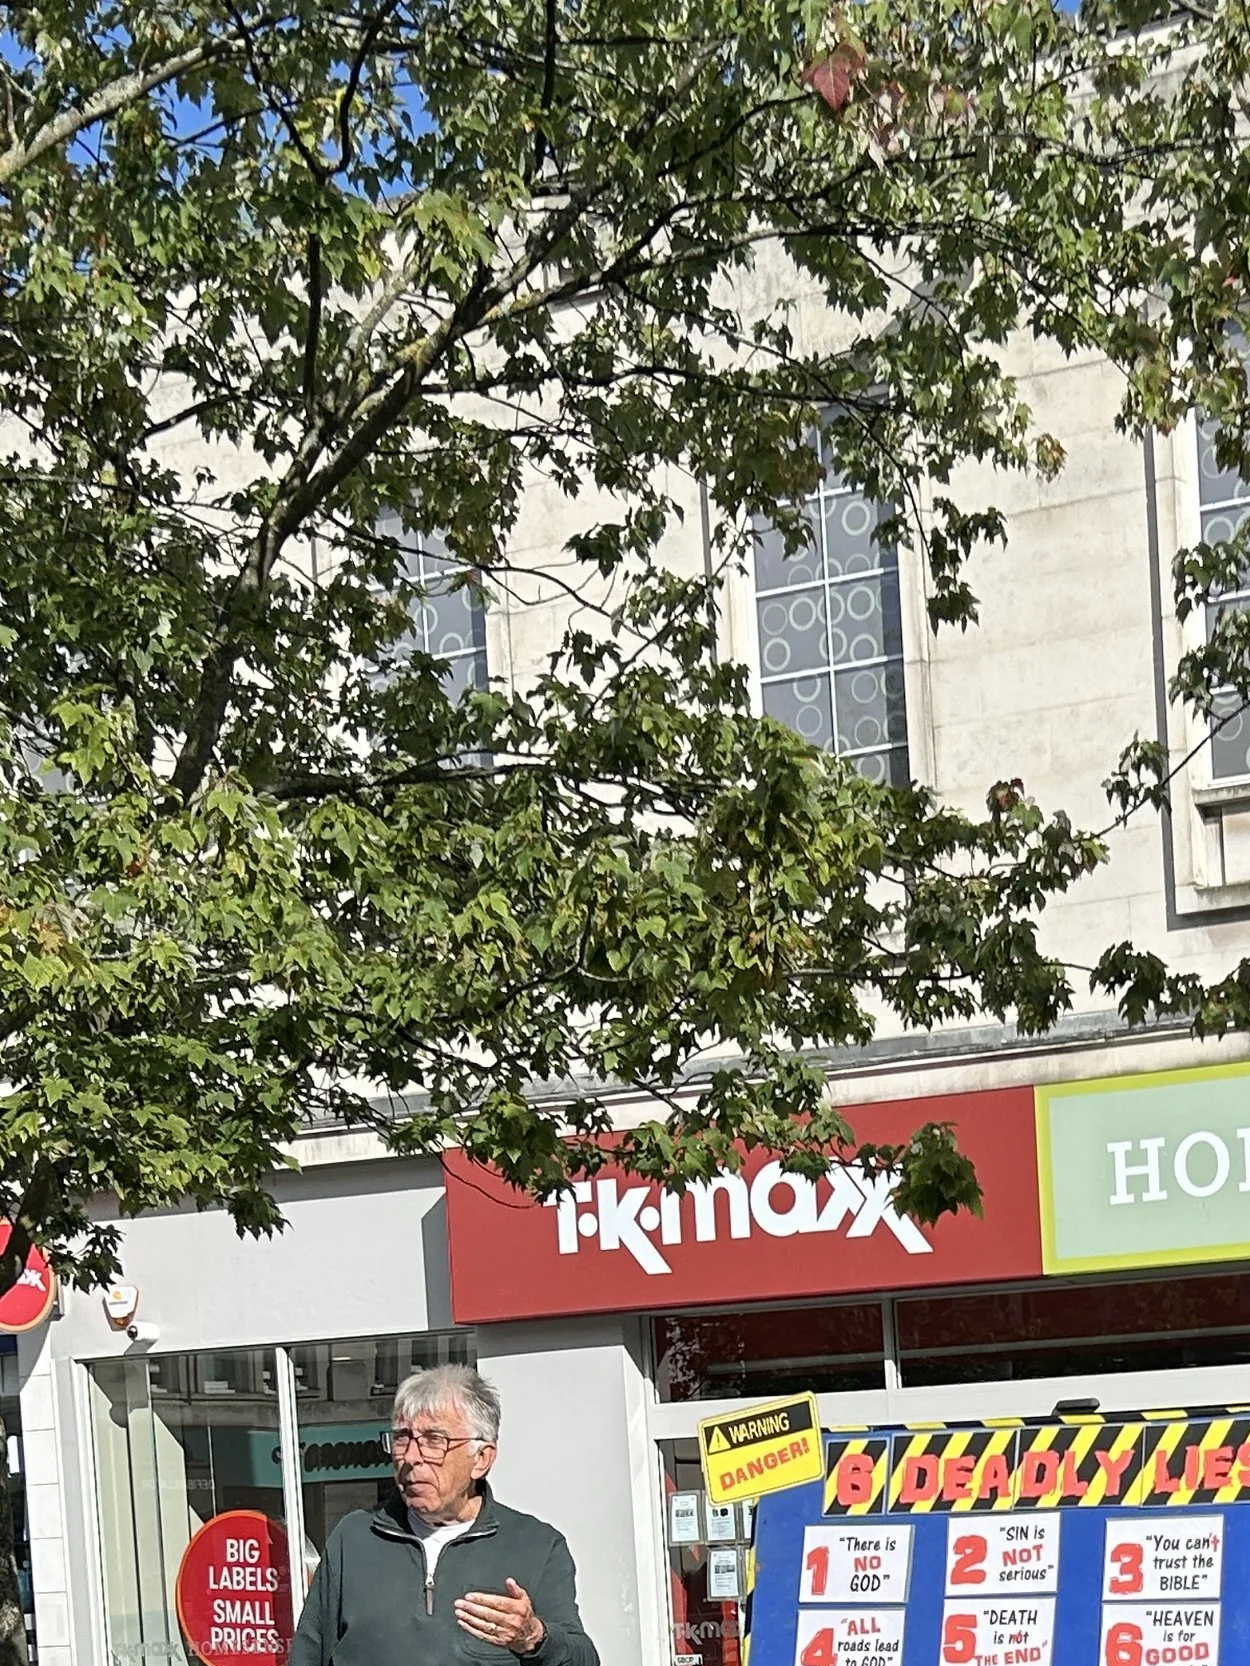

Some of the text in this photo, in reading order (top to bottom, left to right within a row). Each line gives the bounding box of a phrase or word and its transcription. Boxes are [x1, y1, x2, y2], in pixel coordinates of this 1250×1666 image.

[727, 1412, 790, 1444] WARNING
[719, 1437, 810, 1491] DANGER!
[837, 1453, 875, 1506] 6
[900, 1449, 1136, 1503] DEADLY
[885, 1536, 897, 1551] is
[1033, 1525, 1046, 1540] is
[225, 1538, 260, 1564] BIG
[853, 1555, 882, 1573] NO
[950, 1535, 988, 1585] 2
[1002, 1543, 1044, 1567] NOT
[1153, 1554, 1215, 1570] trust the
[208, 1566, 279, 1592] LABELS
[806, 1546, 830, 1596] 1
[1109, 1542, 1144, 1595] 3
[213, 1599, 275, 1625] SMALL
[210, 1626, 280, 1654] PRICES
[838, 1638, 900, 1652] roads lead
[943, 1614, 978, 1664] 5
[993, 1630, 1005, 1645] is
[1162, 1630, 1197, 1643] is for
[1145, 1642, 1210, 1666] GOOD
